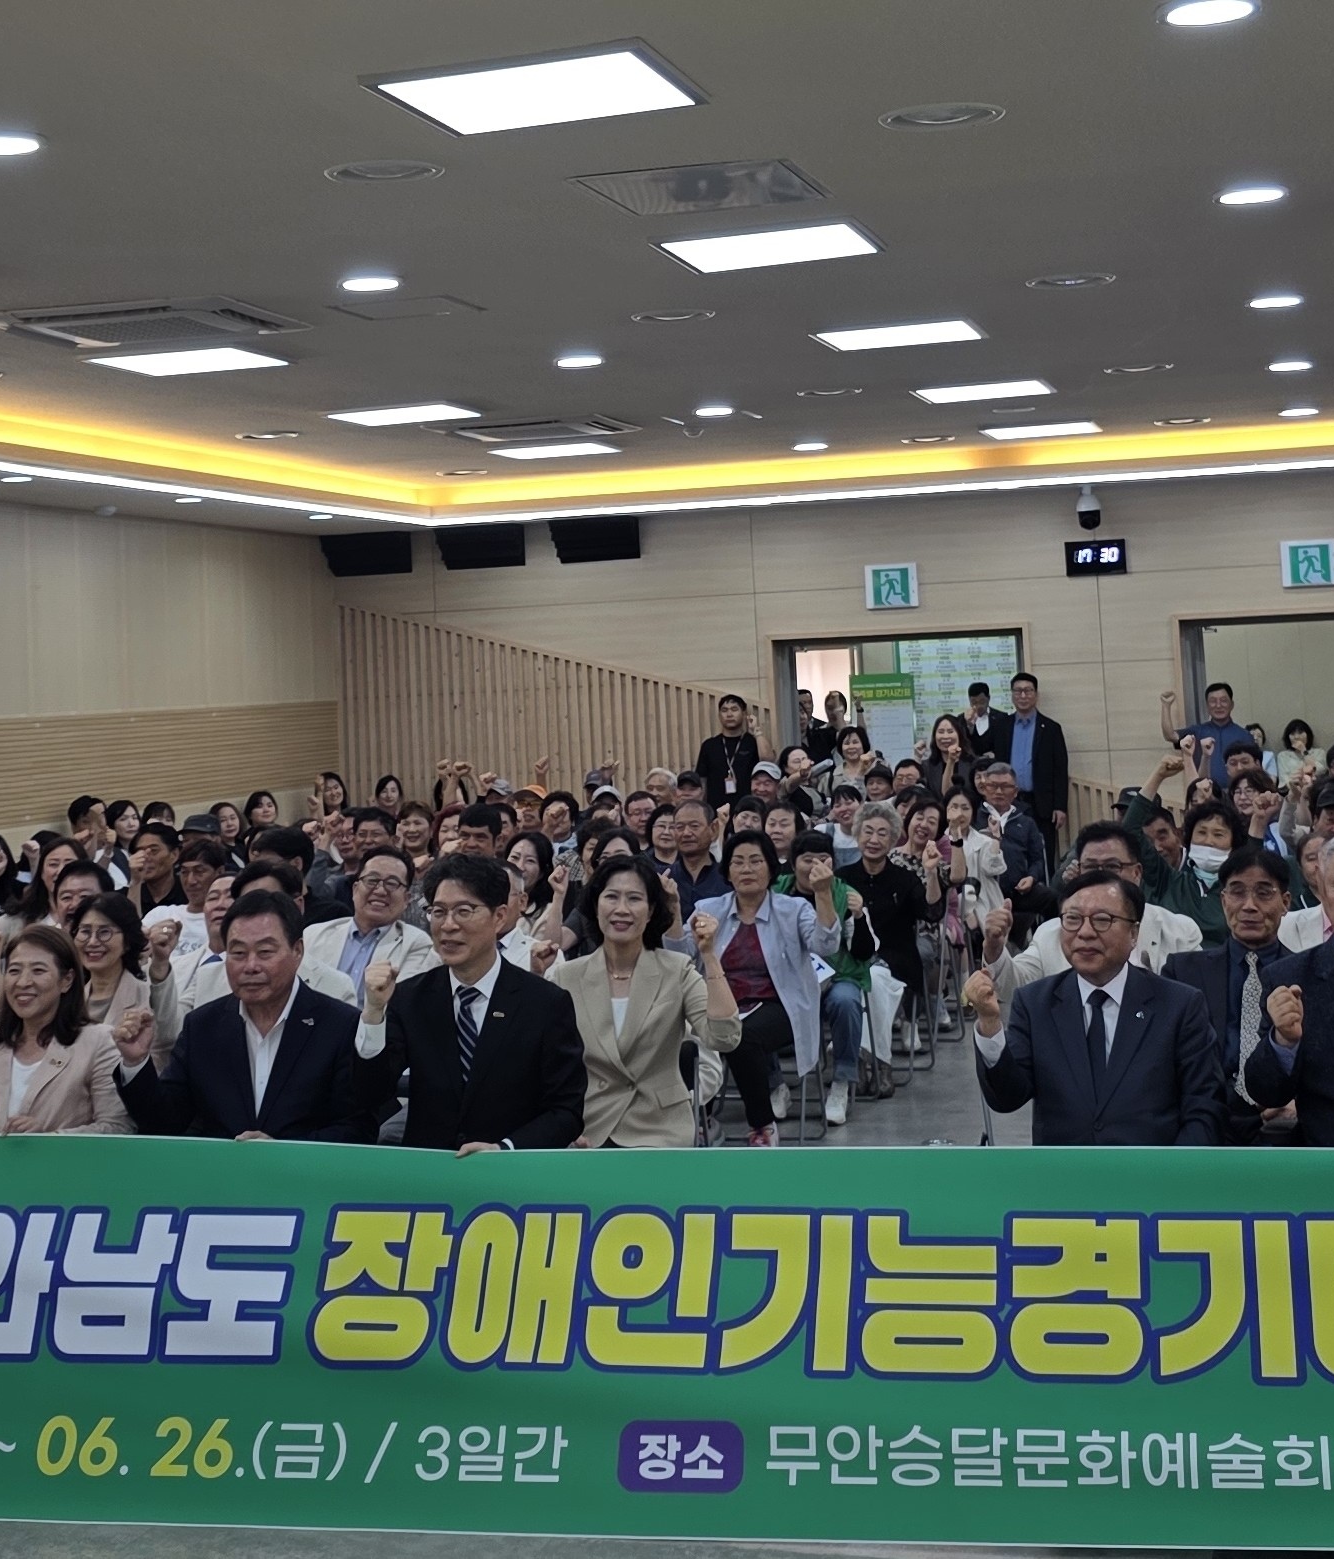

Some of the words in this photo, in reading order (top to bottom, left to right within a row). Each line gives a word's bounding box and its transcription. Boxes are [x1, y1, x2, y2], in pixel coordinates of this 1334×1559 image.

[36, 1415, 129, 1477] 06.
[415, 1425, 569, 1483] 3일간
[638, 1434, 724, 1480] 장소
